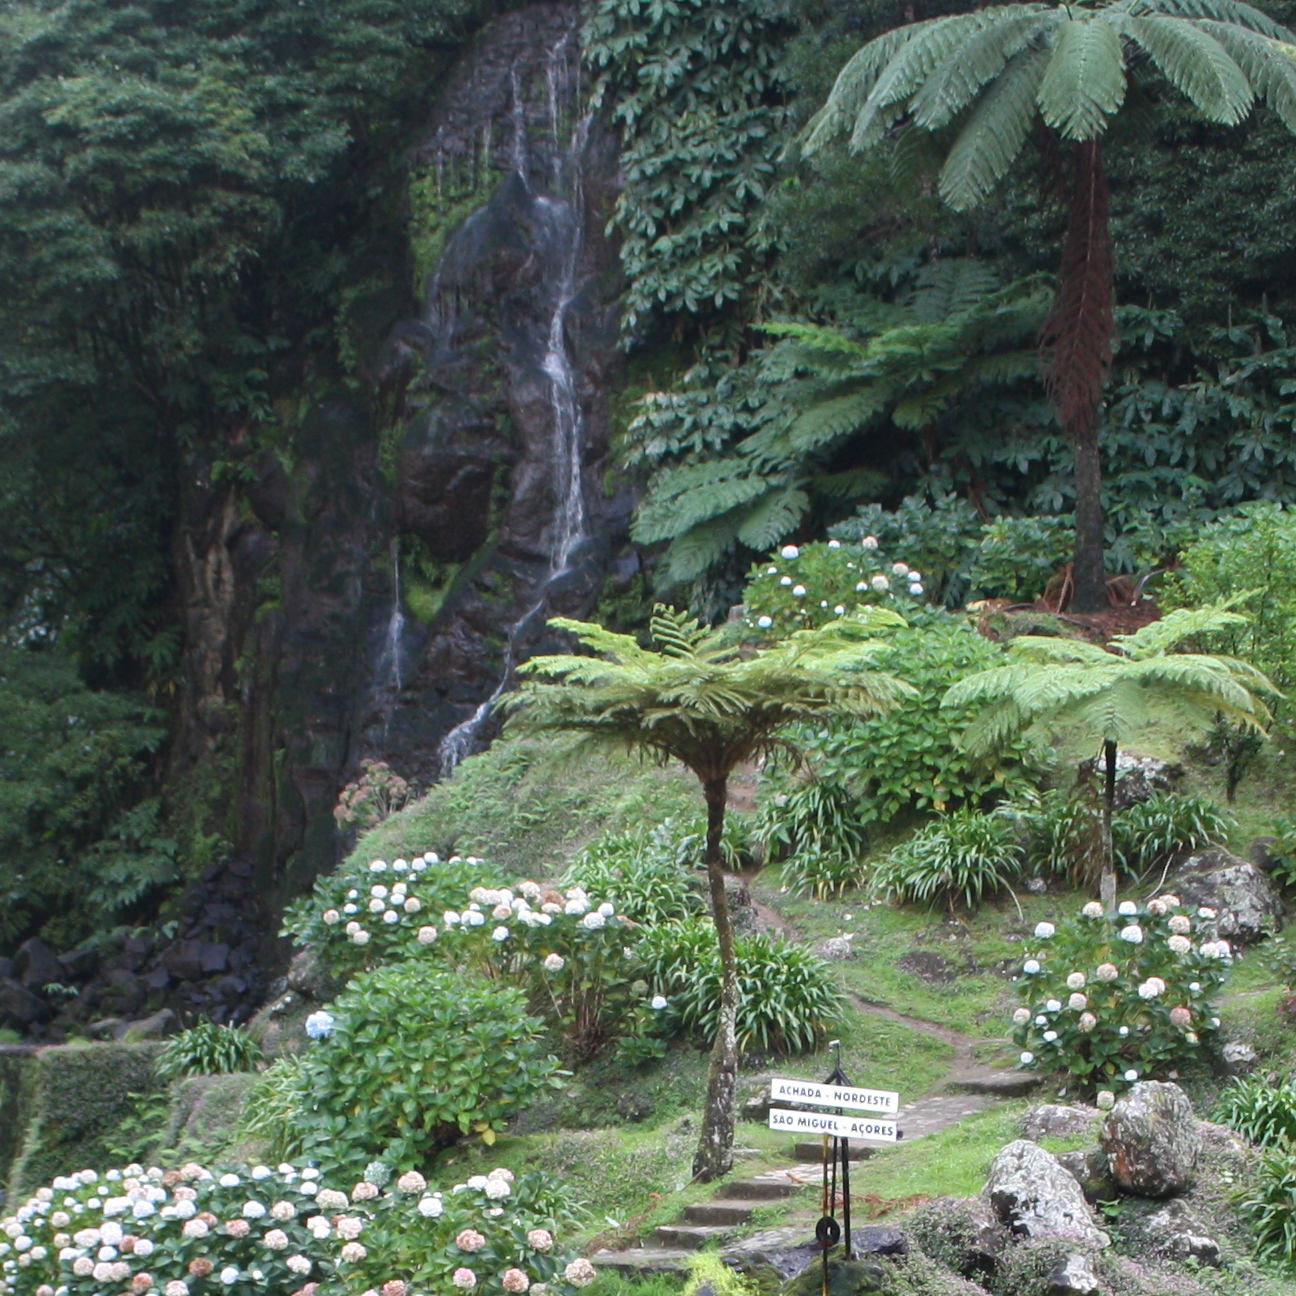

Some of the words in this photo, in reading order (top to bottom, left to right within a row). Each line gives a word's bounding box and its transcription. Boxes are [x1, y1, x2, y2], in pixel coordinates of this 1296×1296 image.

[779, 1085, 822, 1098] ACHADA
[834, 1091, 891, 1107] NORDESTE
[797, 1117, 839, 1131] MIGUEL
[851, 1123, 894, 1138] AÇORES
